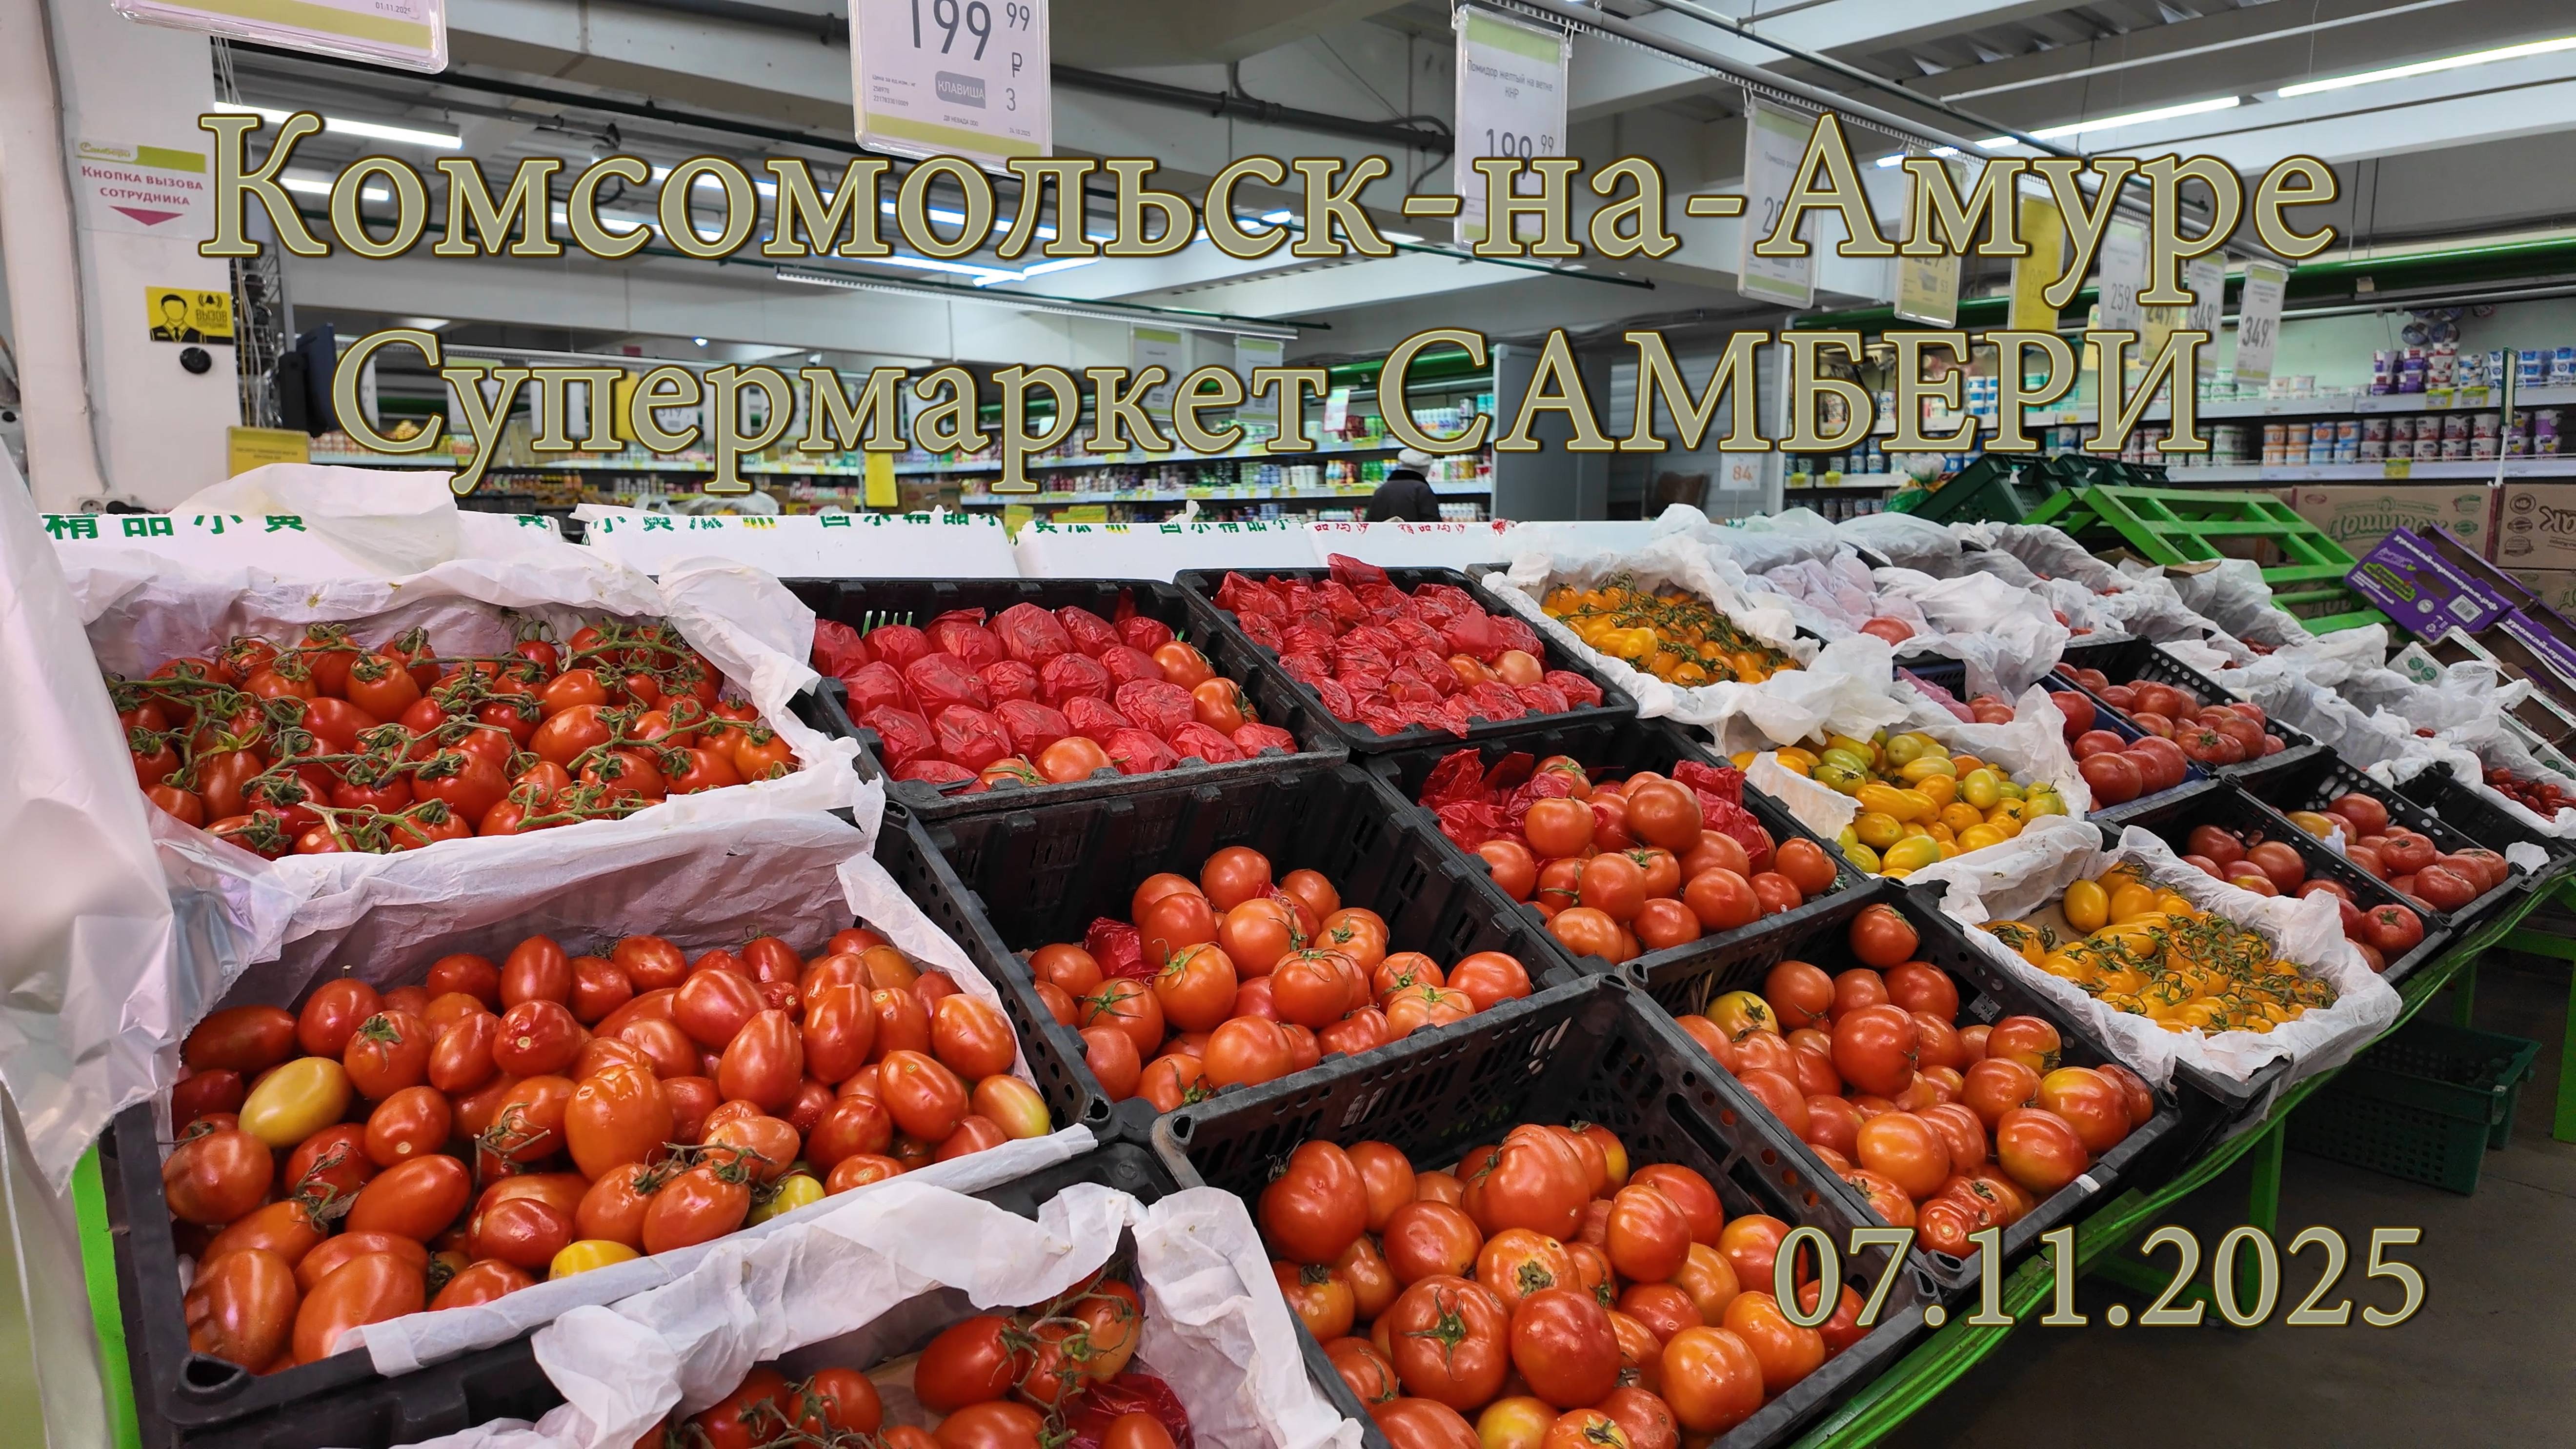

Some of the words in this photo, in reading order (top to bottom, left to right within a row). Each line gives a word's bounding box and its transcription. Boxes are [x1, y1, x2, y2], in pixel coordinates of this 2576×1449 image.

[912, 0, 991, 60] 199
[1006, 2, 1029, 31] 99
[937, 80, 985, 99] КЛАВИША
[2110, 282, 2131, 312] 259
[2242, 315, 2270, 349] 349
